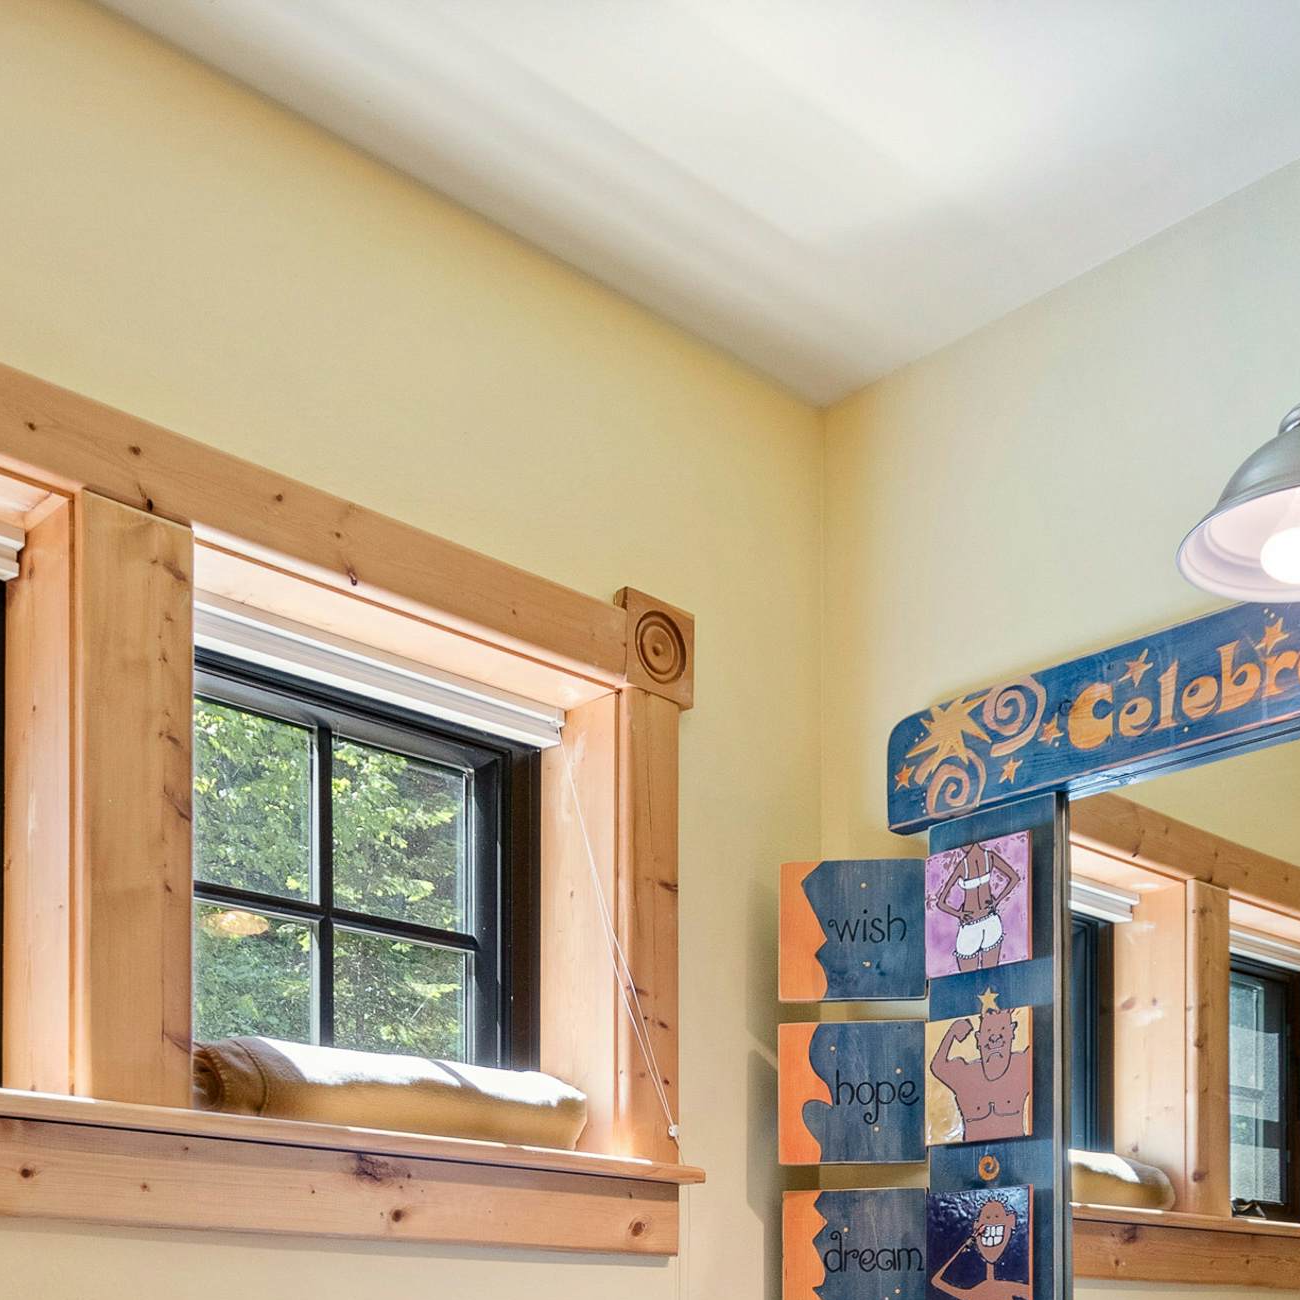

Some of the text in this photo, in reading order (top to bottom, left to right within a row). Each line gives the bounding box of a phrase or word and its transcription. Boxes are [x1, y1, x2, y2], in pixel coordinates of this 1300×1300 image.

[827, 903, 908, 944] wish
[835, 1068, 921, 1126] hope
[823, 1230, 926, 1274] dream
